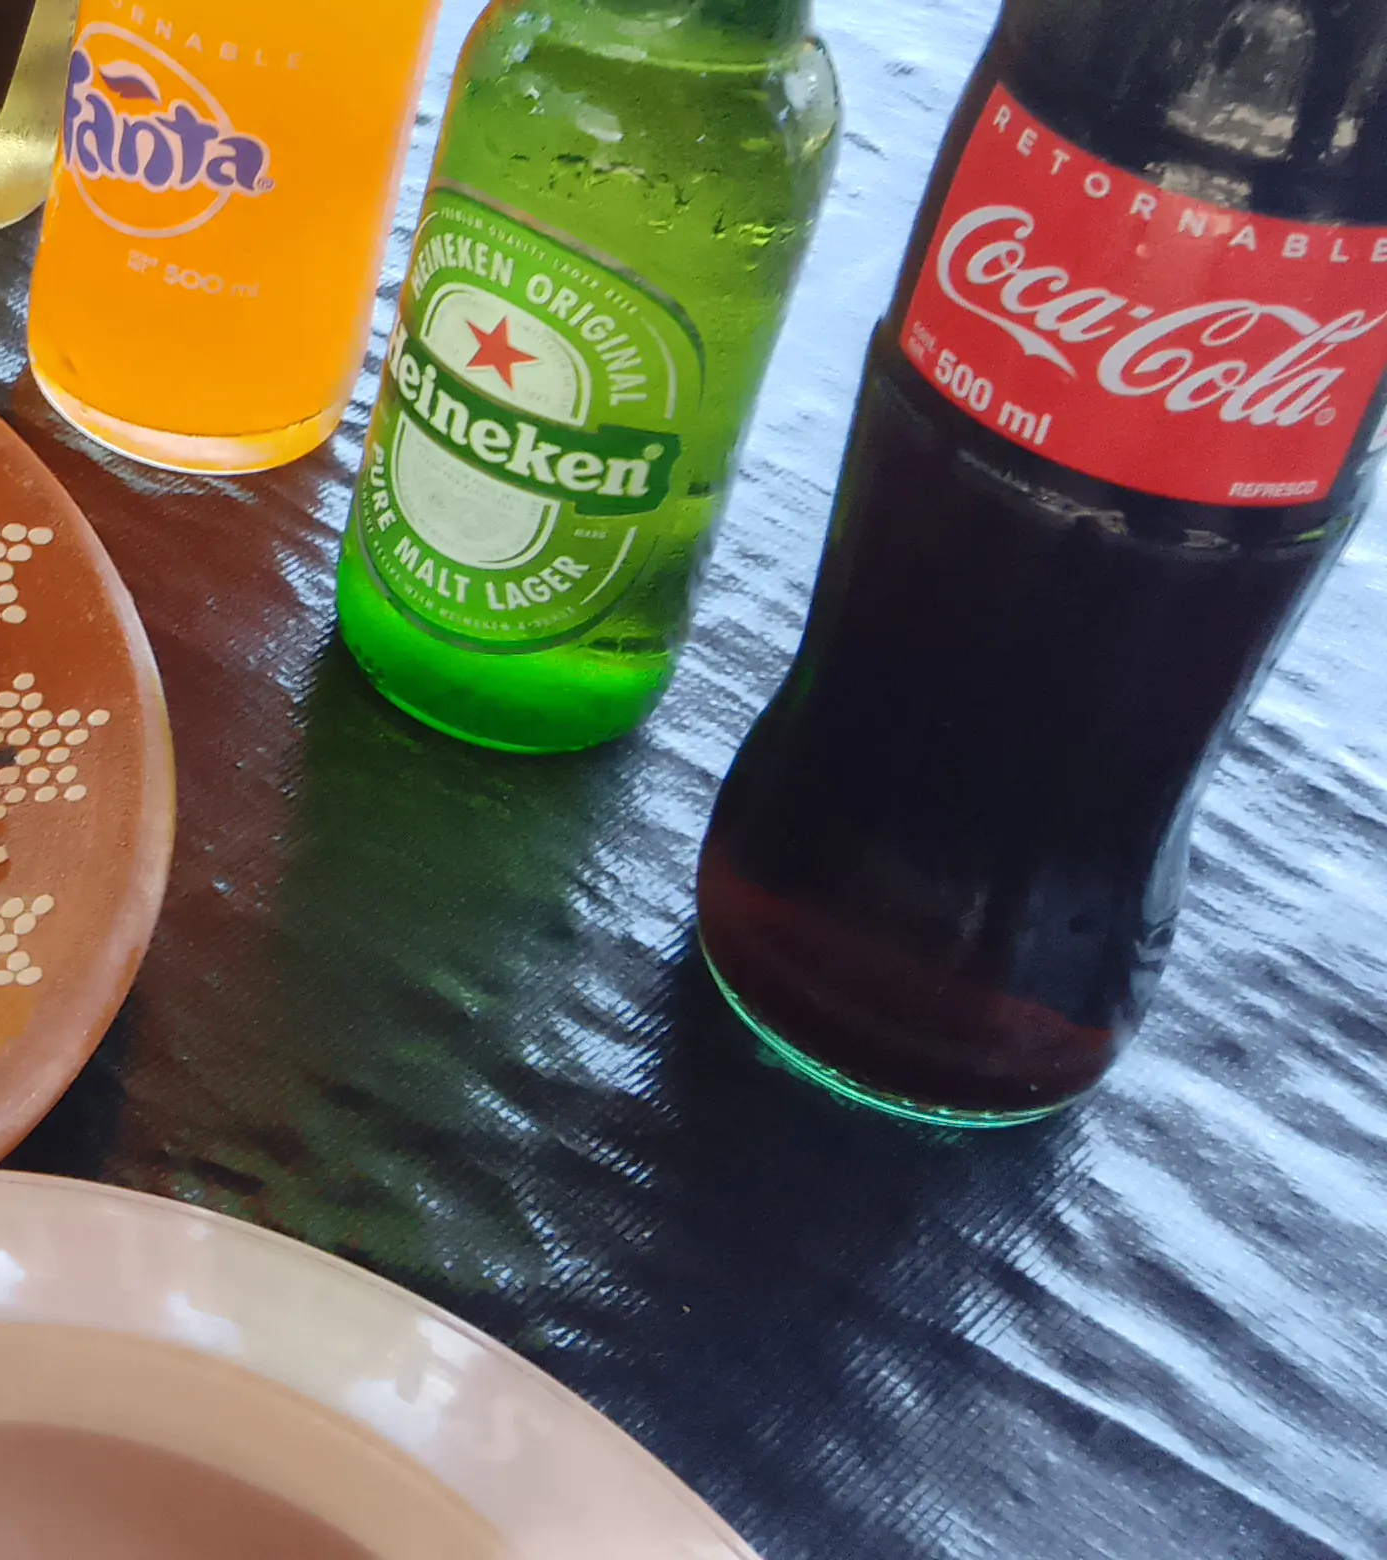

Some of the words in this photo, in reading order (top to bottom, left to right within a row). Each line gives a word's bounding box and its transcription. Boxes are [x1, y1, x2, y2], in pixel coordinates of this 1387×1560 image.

[488, 224, 547, 261] QUALITY
[992, 103, 1387, 263] RETORNABLE
[163, 262, 225, 295] 500
[410, 232, 515, 300] HEINEKEN
[525, 273, 648, 407] ORIGINAL
[936, 205, 1387, 426] Coca-Cola
[387, 316, 649, 497] Heineken
[934, 348, 994, 413] 500
[997, 400, 1053, 446] ml
[369, 441, 398, 533] PURE
[392, 534, 471, 604] MALT
[484, 554, 591, 611] LAGER
[1228, 479, 1319, 498] REFRESCO
